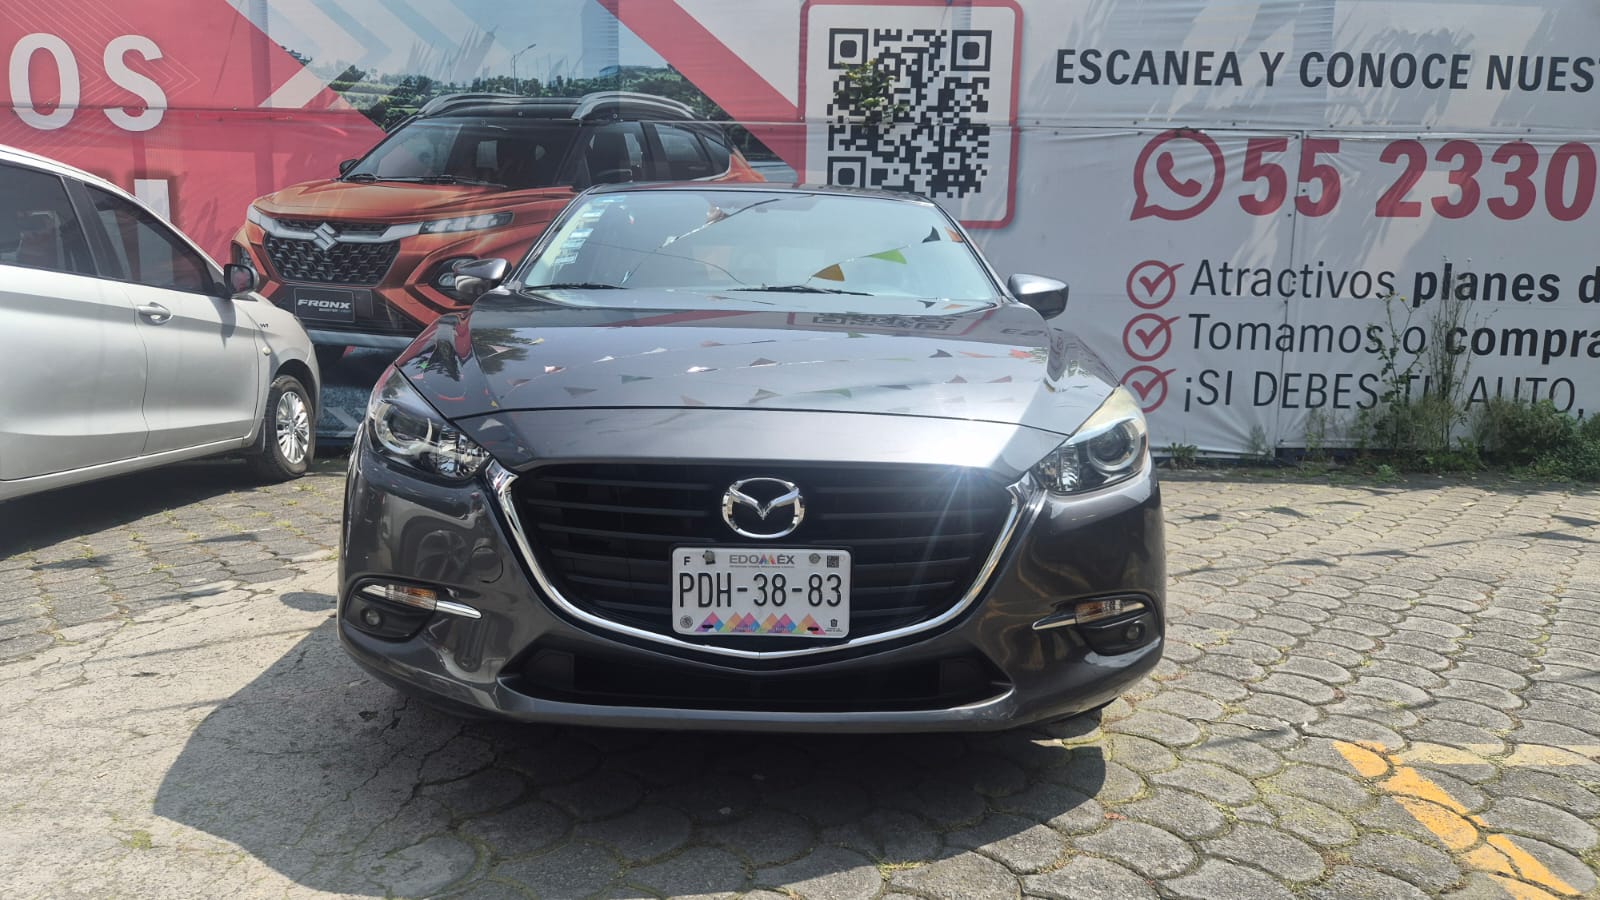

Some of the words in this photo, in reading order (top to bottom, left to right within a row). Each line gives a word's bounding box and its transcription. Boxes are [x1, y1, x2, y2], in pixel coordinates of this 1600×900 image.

[9, 32, 168, 132] OS
[1055, 48, 1243, 86] ESCANEA
[1259, 51, 1285, 87] Y
[1299, 51, 1471, 89] CONOCE
[1485, 55, 1600, 93] NUES
[1238, 137, 1341, 217] 55
[1375, 139, 1598, 222] 2330
[297, 299, 351, 309] FRONX
[1189, 258, 1396, 299] Atractivos
[1412, 262, 1561, 308] planes
[1188, 313, 1384, 353] Tomamos
[1402, 325, 1426, 354] o
[1183, 369, 1234, 413] ¡SI
[1253, 371, 1379, 410] DEBES
[1463, 375, 1585, 421] AUTO,
[683, 556, 691, 566] F
[679, 572, 842, 608] PDH-38-83
